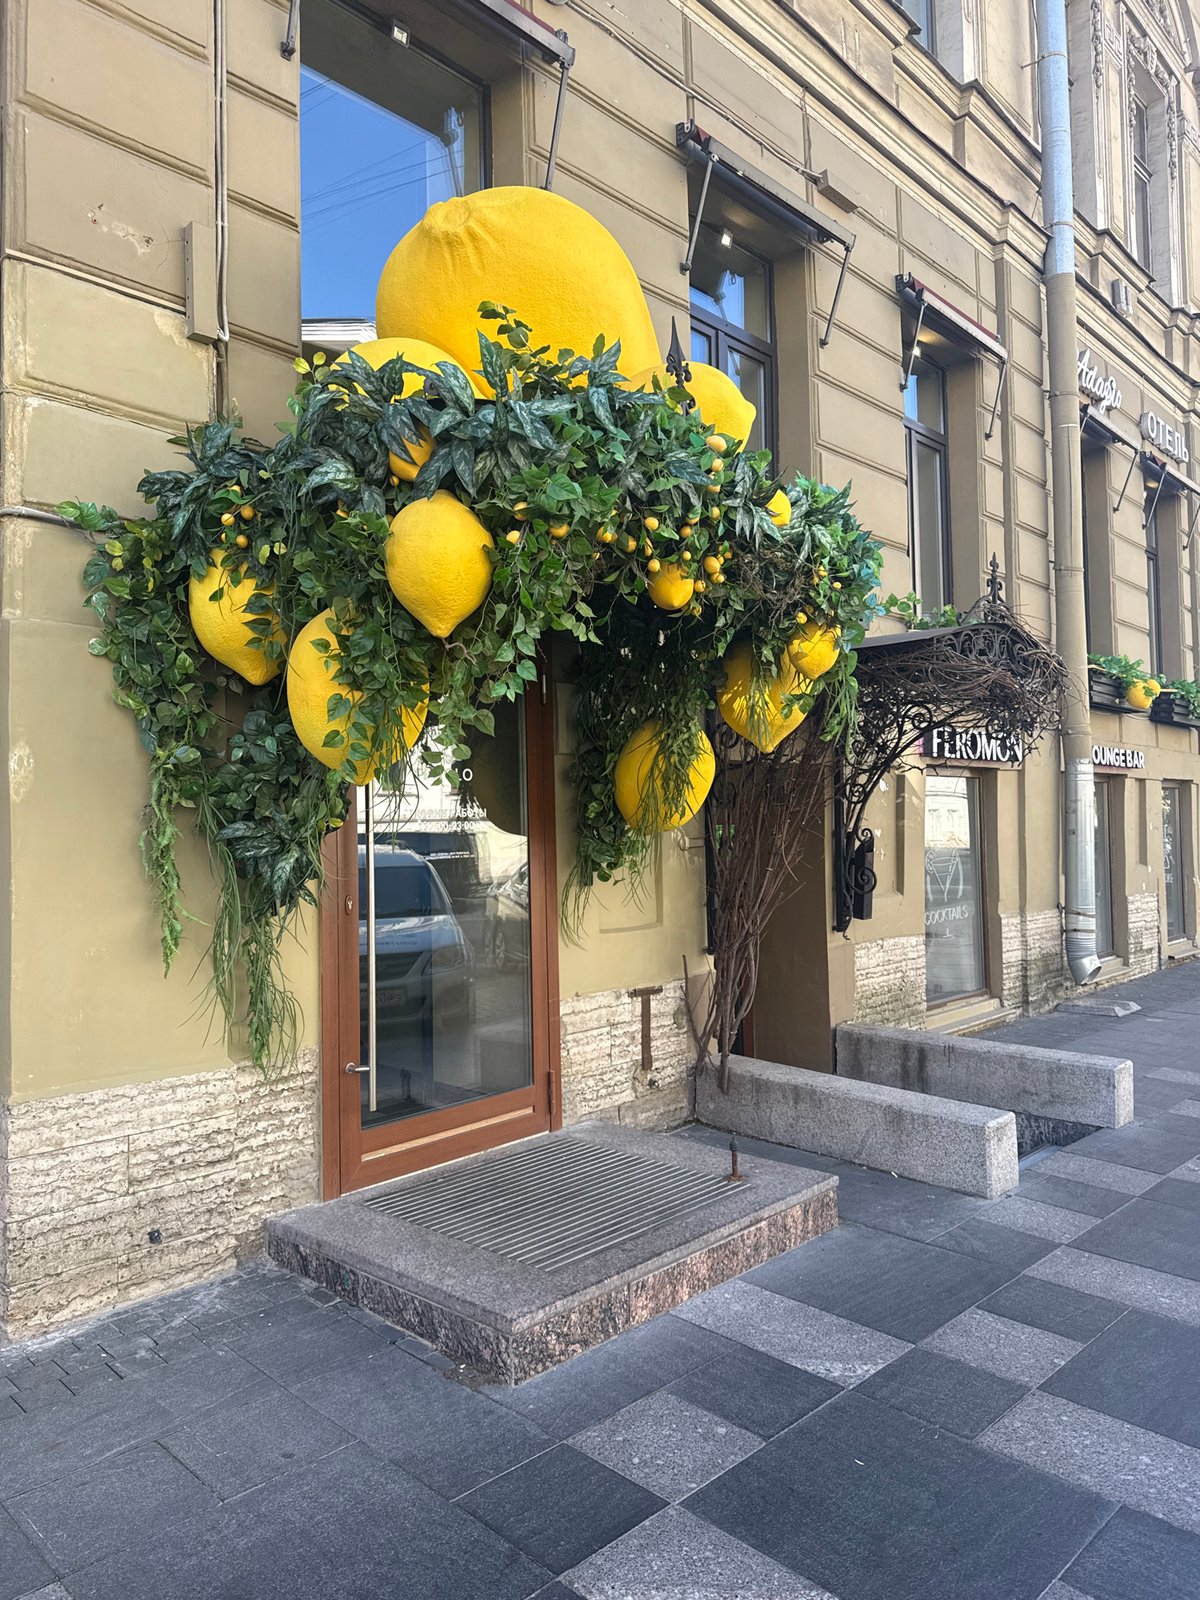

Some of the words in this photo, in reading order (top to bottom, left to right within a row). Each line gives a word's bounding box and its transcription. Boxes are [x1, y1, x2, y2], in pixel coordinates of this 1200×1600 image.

[1147, 411, 1189, 462] ОТЕЛЬ
[1092, 744, 1126, 767] OUNGE
[1126, 749, 1145, 769] BAR
[925, 905, 969, 926] COCKTAILS
